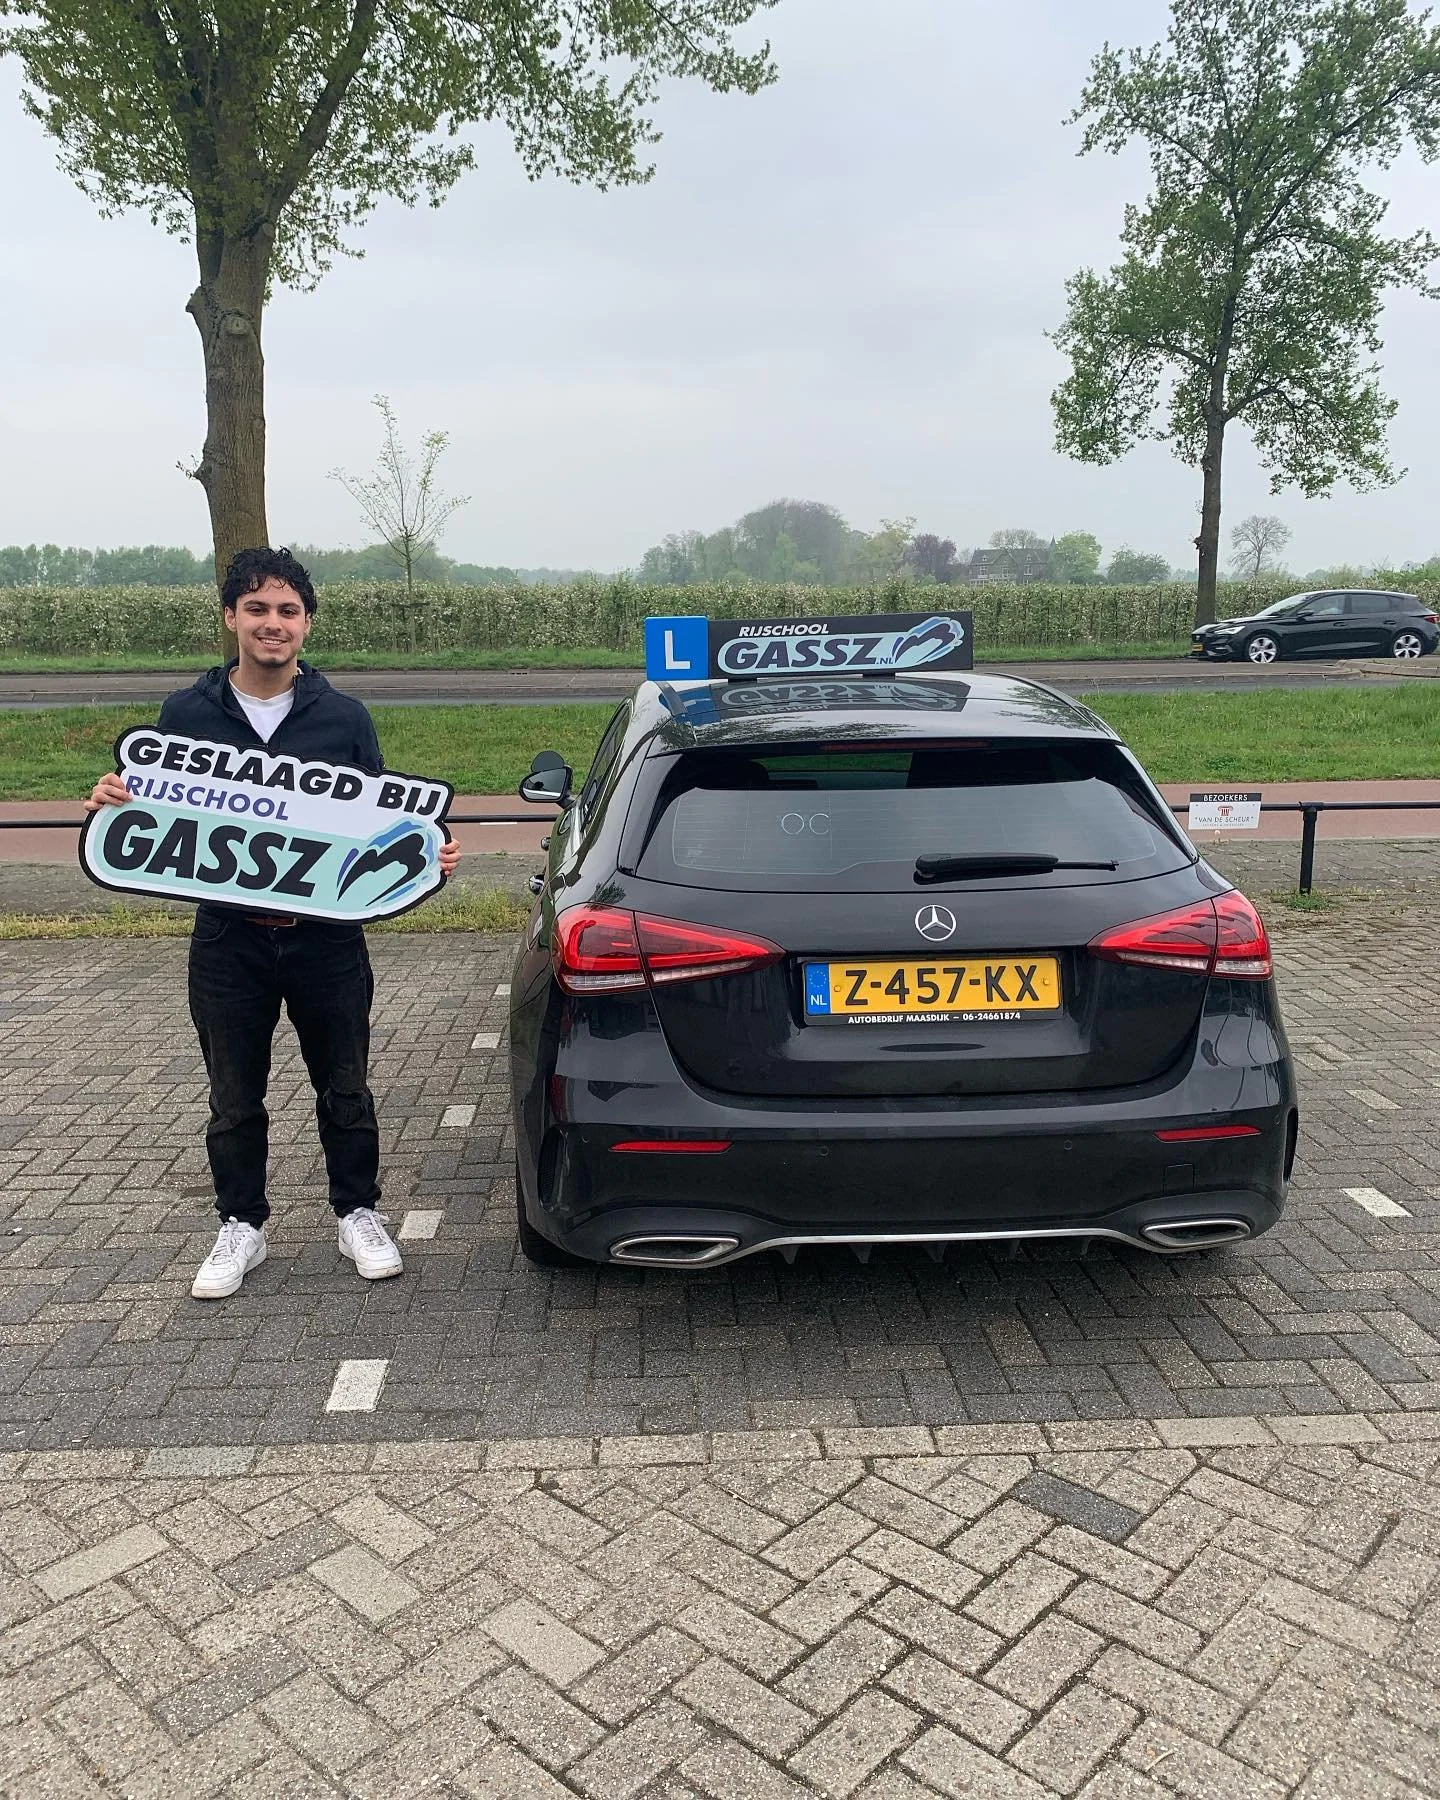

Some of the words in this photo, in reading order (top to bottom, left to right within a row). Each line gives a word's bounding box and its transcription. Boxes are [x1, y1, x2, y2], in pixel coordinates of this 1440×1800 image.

[664, 630, 691, 670] L
[738, 623, 830, 637] RIJSCHOOL
[127, 737, 363, 801] GESLAAGD
[377, 781, 442, 816] BIJ
[126, 775, 289, 821] RIJSCHOOL
[1203, 794, 1248, 802] BEZOEKERS
[102, 809, 334, 898] GASSZ
[810, 994, 828, 1006] NL
[844, 964, 1041, 1006] Z-457-KX
[848, 1014, 904, 1024] AUTOBEDRIJF
[906, 1013, 950, 1022] MAASDIJK
[962, 1012, 1021, 1021] 06-24661874
